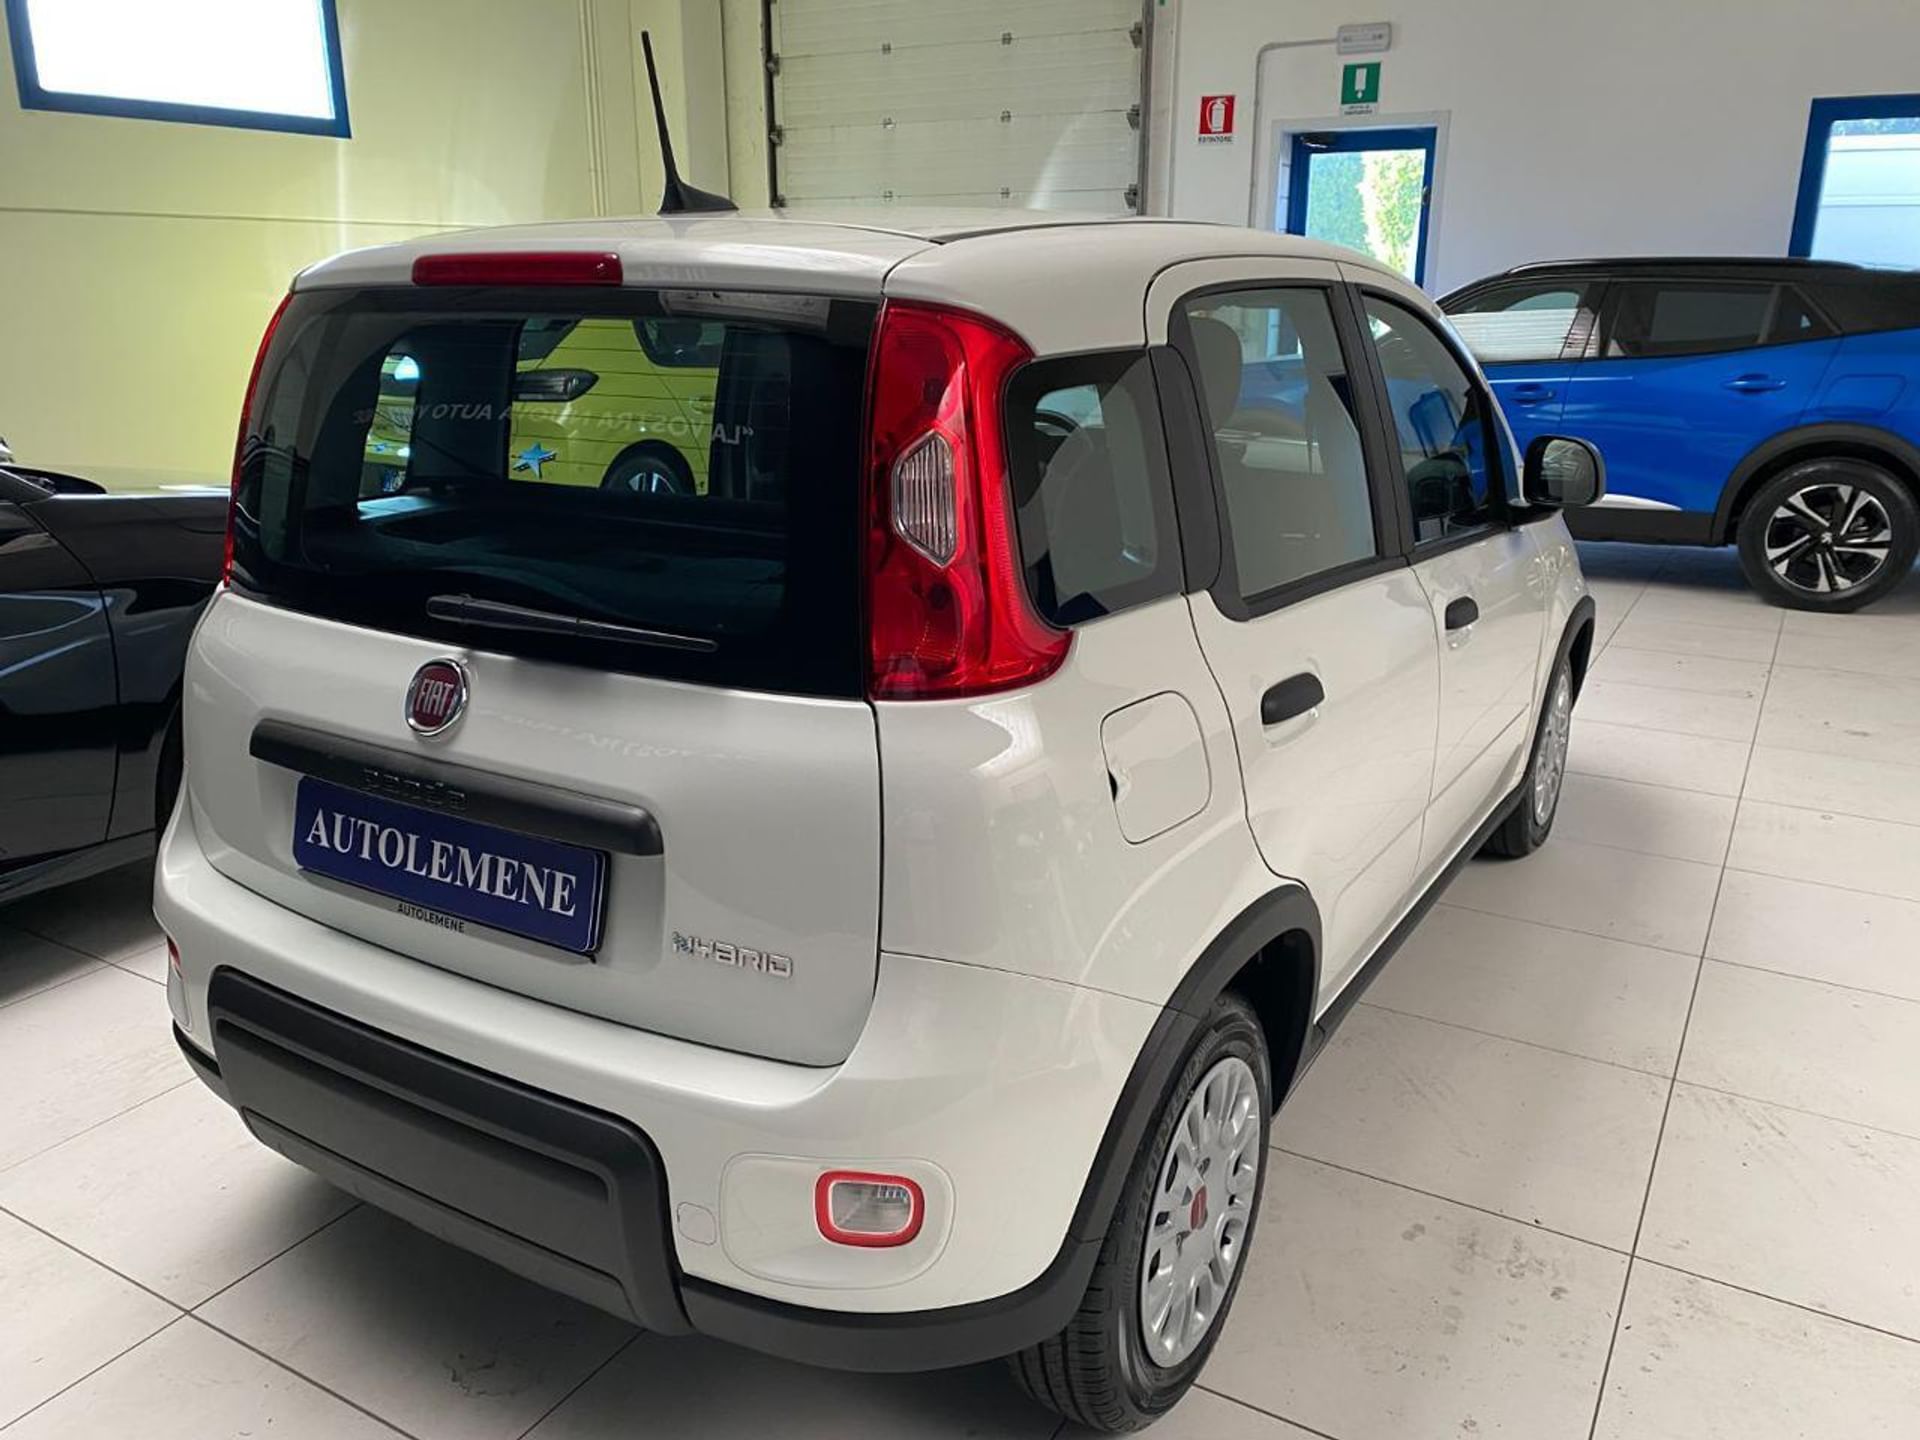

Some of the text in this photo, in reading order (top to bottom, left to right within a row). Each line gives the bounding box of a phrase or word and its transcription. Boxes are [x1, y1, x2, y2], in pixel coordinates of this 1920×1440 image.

[418, 678, 455, 716] FIAT
[306, 808, 577, 917] AUTOLEMENE
[397, 902, 465, 933] AUTOLEMENE
